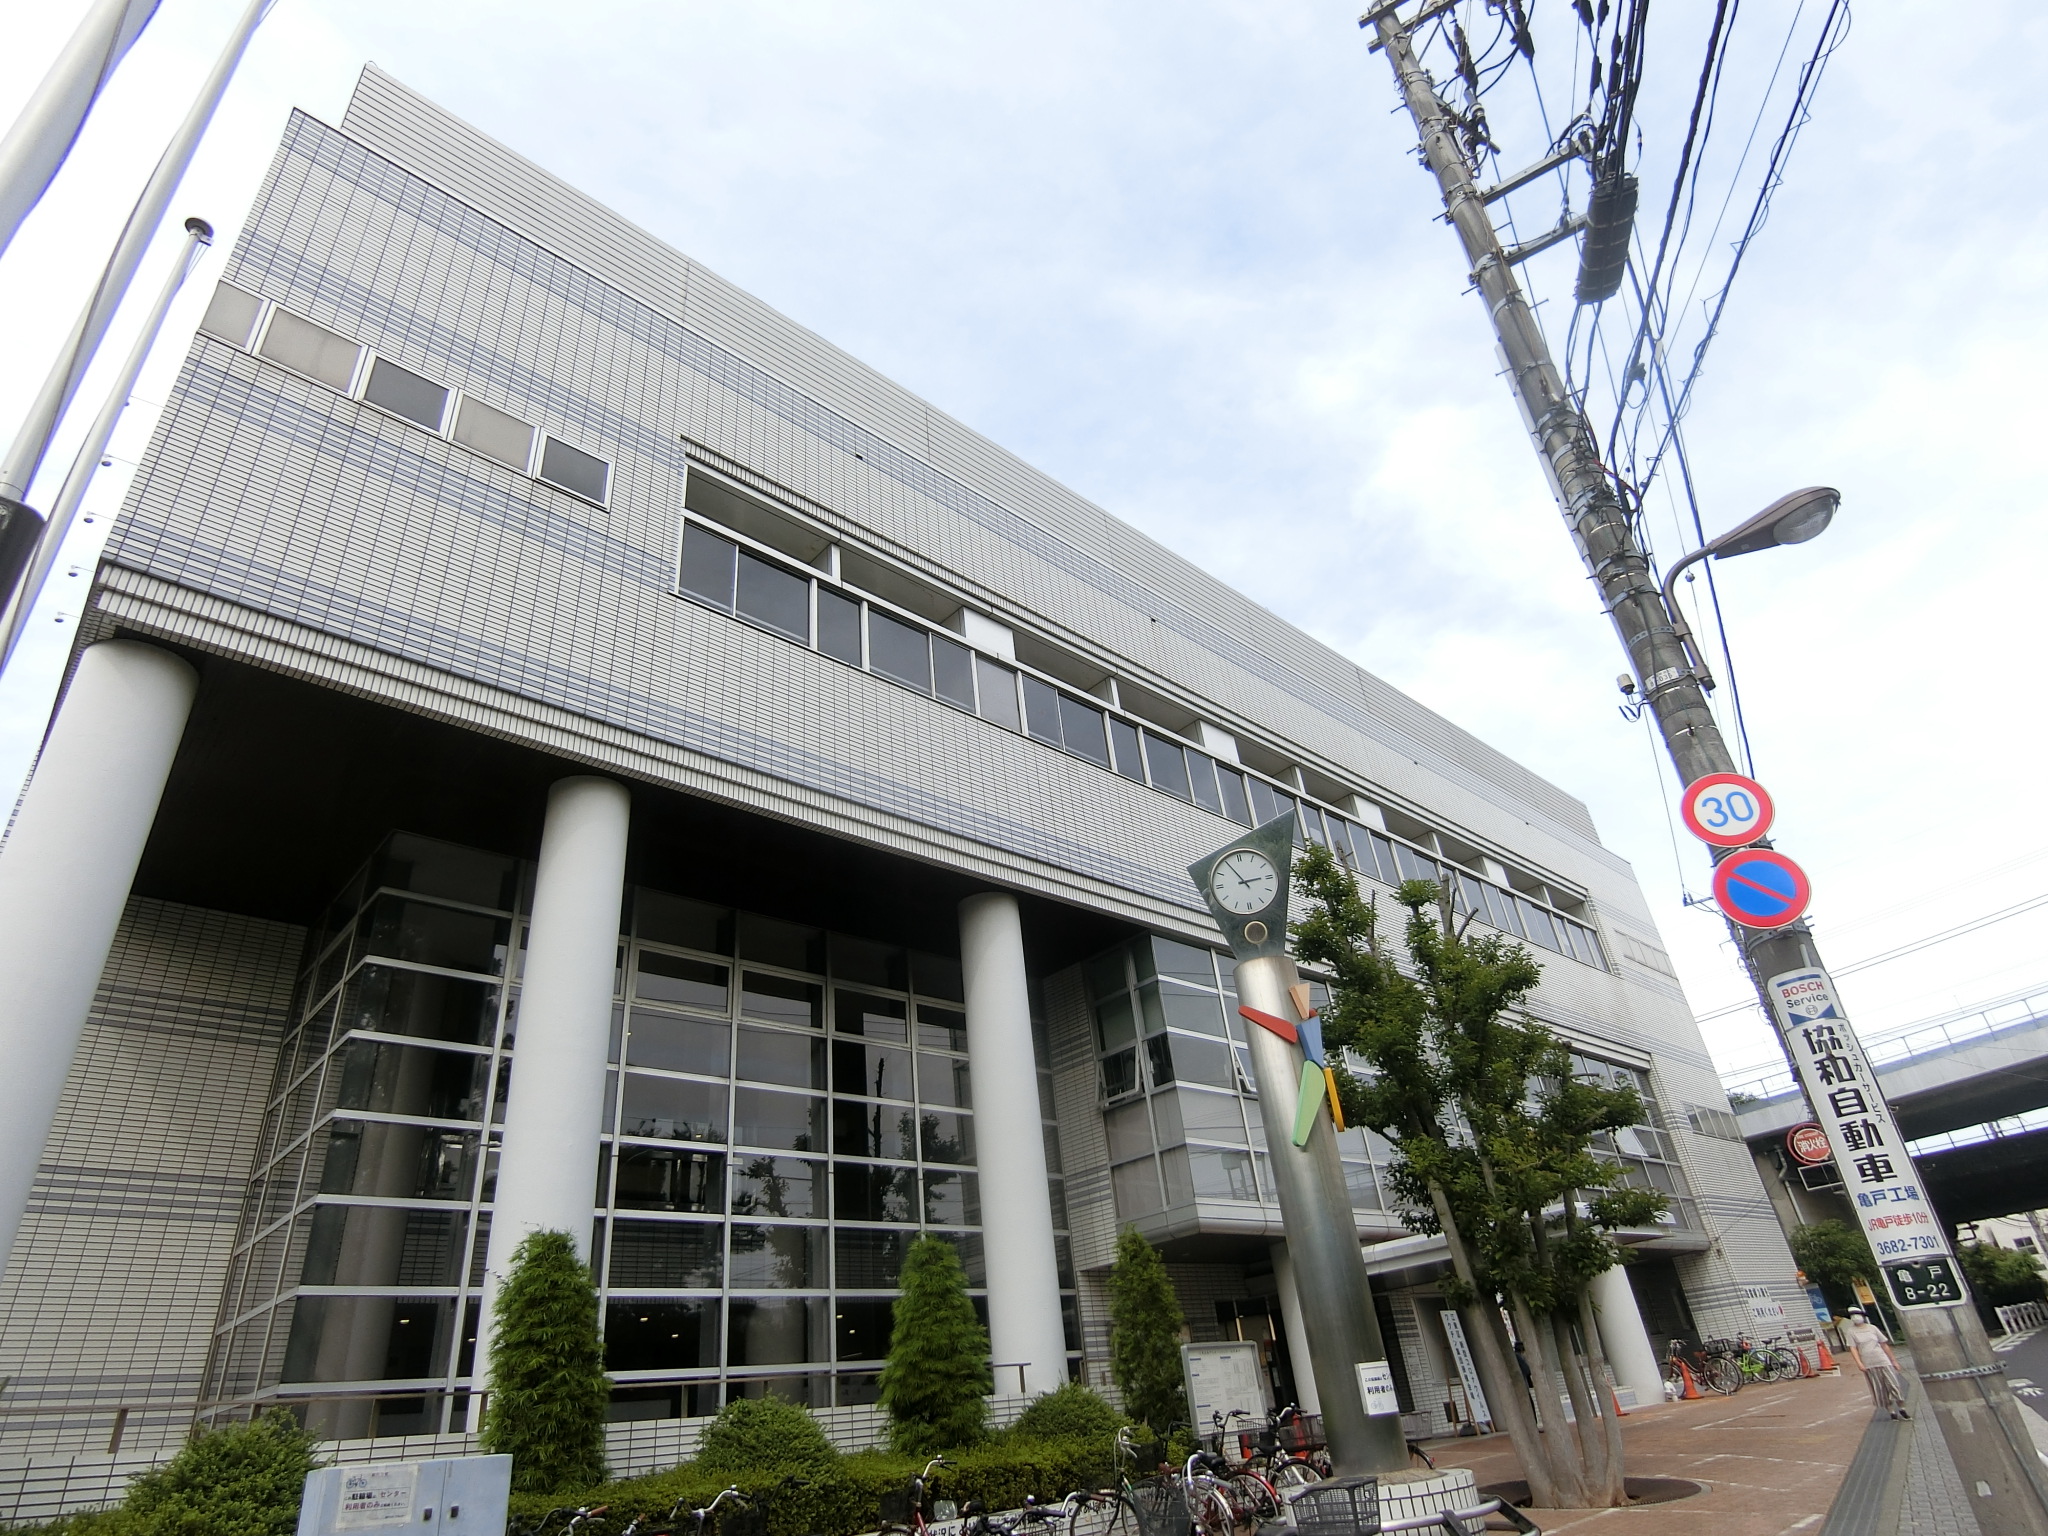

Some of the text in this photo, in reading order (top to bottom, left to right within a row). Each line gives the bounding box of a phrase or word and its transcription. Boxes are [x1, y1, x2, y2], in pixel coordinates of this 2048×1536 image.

[1702, 791, 1754, 827] 30
[1781, 981, 1825, 998] BOSCH
[1786, 993, 1829, 1008] Service
[1802, 1024, 1898, 1183] 協和自動車
[1797, 1136, 1829, 1153] 消火栓
[1857, 1185, 1920, 1207] 亀戸工場
[1868, 1212, 1929, 1231] JR亀戸徒歩10分
[1876, 1235, 1940, 1255] 3682-7301
[1904, 1283, 1951, 1300] 8-22
